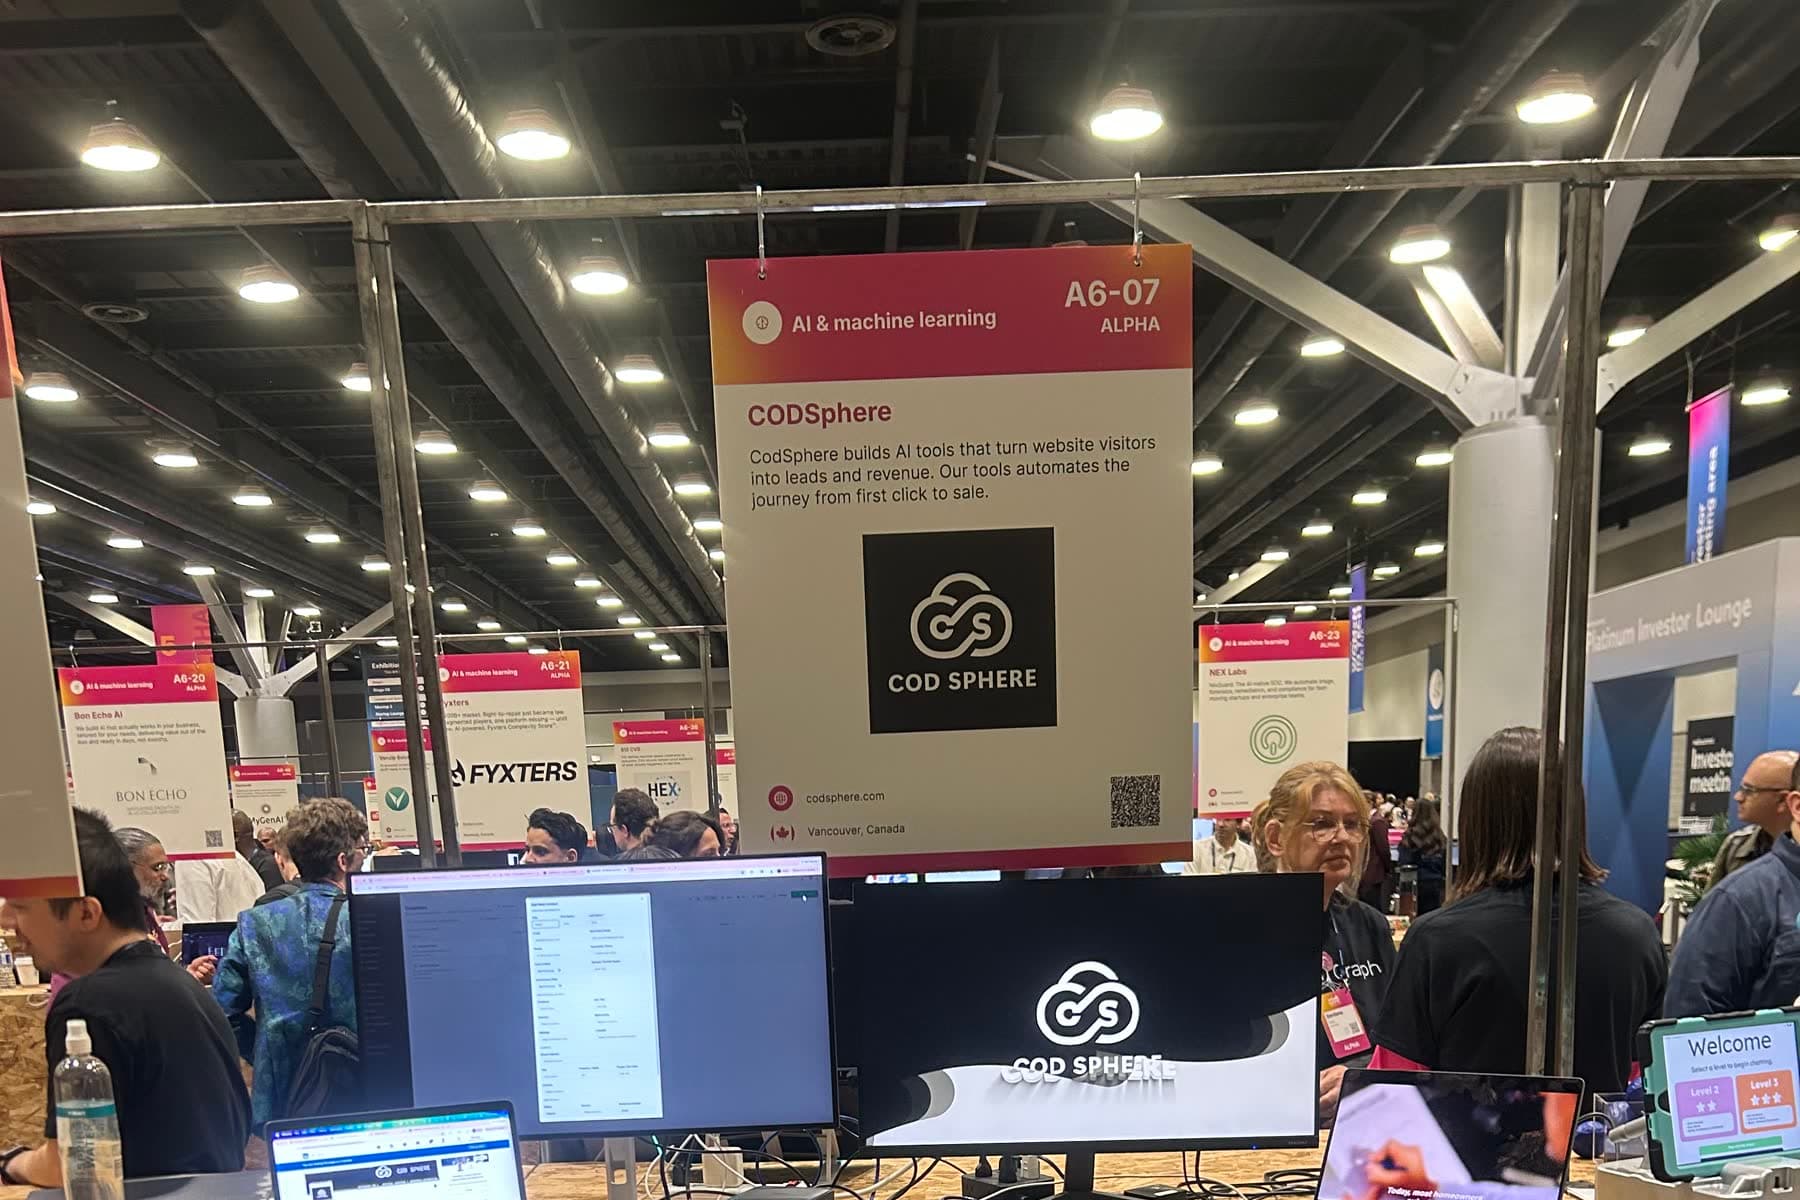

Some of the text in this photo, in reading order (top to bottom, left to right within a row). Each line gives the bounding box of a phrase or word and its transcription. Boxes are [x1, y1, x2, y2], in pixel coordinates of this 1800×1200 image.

[1064, 278, 1161, 308] A6-07
[792, 310, 997, 333] AI & machine learning
[1100, 316, 1161, 334] ALPHA
[747, 403, 892, 429] CODSphere
[750, 435, 1156, 467] CodSphere builds AI tools that turn website visitors
[751, 457, 1130, 487] into leads and revenue. Our tools automates the
[751, 484, 989, 511] journey from first click to sale.
[1638, 612, 1692, 642] Investor
[1696, 597, 1752, 629] Lounge
[1309, 630, 1340, 641] A6-23
[160, 636, 177, 657] 5
[541, 661, 570, 671] A6-21
[1227, 668, 1247, 676] Labs
[173, 674, 206, 684] A6-20
[888, 668, 1038, 694] COD SPHERE
[74, 710, 123, 720] Bon Echo AI
[1691, 747, 1734, 769] Investo
[469, 760, 578, 784] FYXTERS
[1690, 769, 1732, 793] meetin
[116, 789, 187, 802] BON ECHO
[647, 782, 679, 797] HEX
[806, 790, 885, 806] codsphere.com
[807, 823, 905, 839] Vancouver, Canada
[1688, 1034, 1772, 1057] Welcome
[1690, 1086, 1712, 1097] Level
[1750, 1079, 1771, 1090] Level
